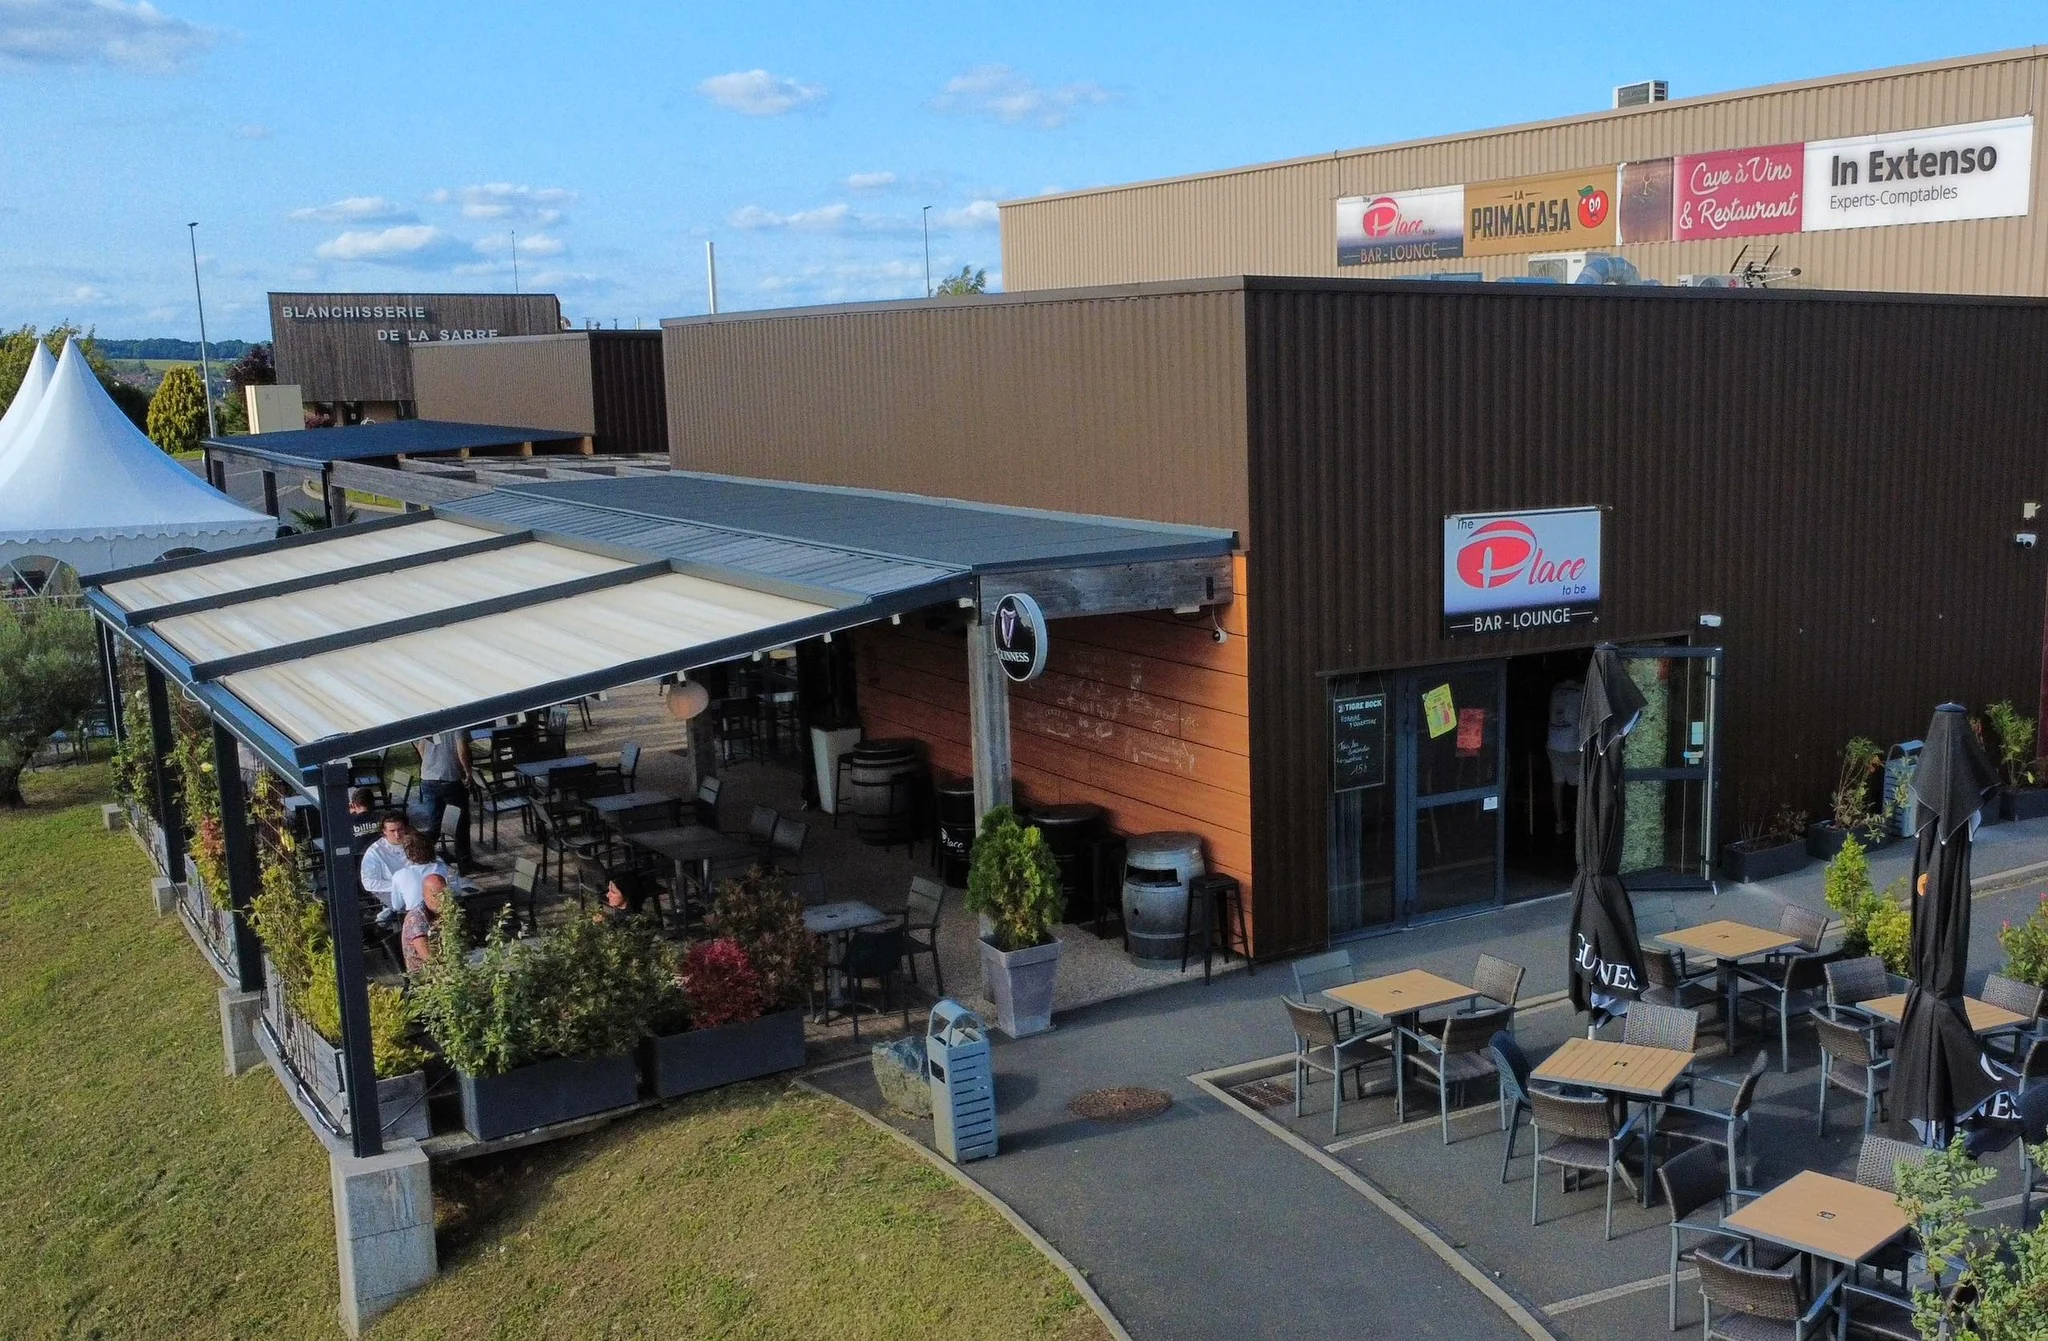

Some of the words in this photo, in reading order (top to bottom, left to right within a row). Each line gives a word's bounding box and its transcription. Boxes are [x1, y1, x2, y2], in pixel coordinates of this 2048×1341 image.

[1690, 162, 1733, 196] Cave
[1735, 163, 1748, 183] à
[1746, 157, 1793, 183] Vins
[1831, 155, 1858, 187] In
[1868, 145, 1998, 183] Extenso
[1514, 190, 1524, 200] LA
[1679, 201, 1693, 229] &
[1698, 192, 1799, 231] Restaurant
[1830, 185, 1958, 212] Experts-Comptables
[1363, 196, 1424, 239] Place
[1471, 198, 1571, 239] PRIMACASA
[282, 306, 426, 318] BLANCHISSERIE
[377, 329, 400, 341] DE
[408, 329, 429, 341] LA
[439, 328, 498, 341] SARRE
[1457, 519, 1474, 530] The
[1456, 520, 1586, 589] Place
[1562, 584, 1571, 595] to
[1574, 584, 1587, 595] be
